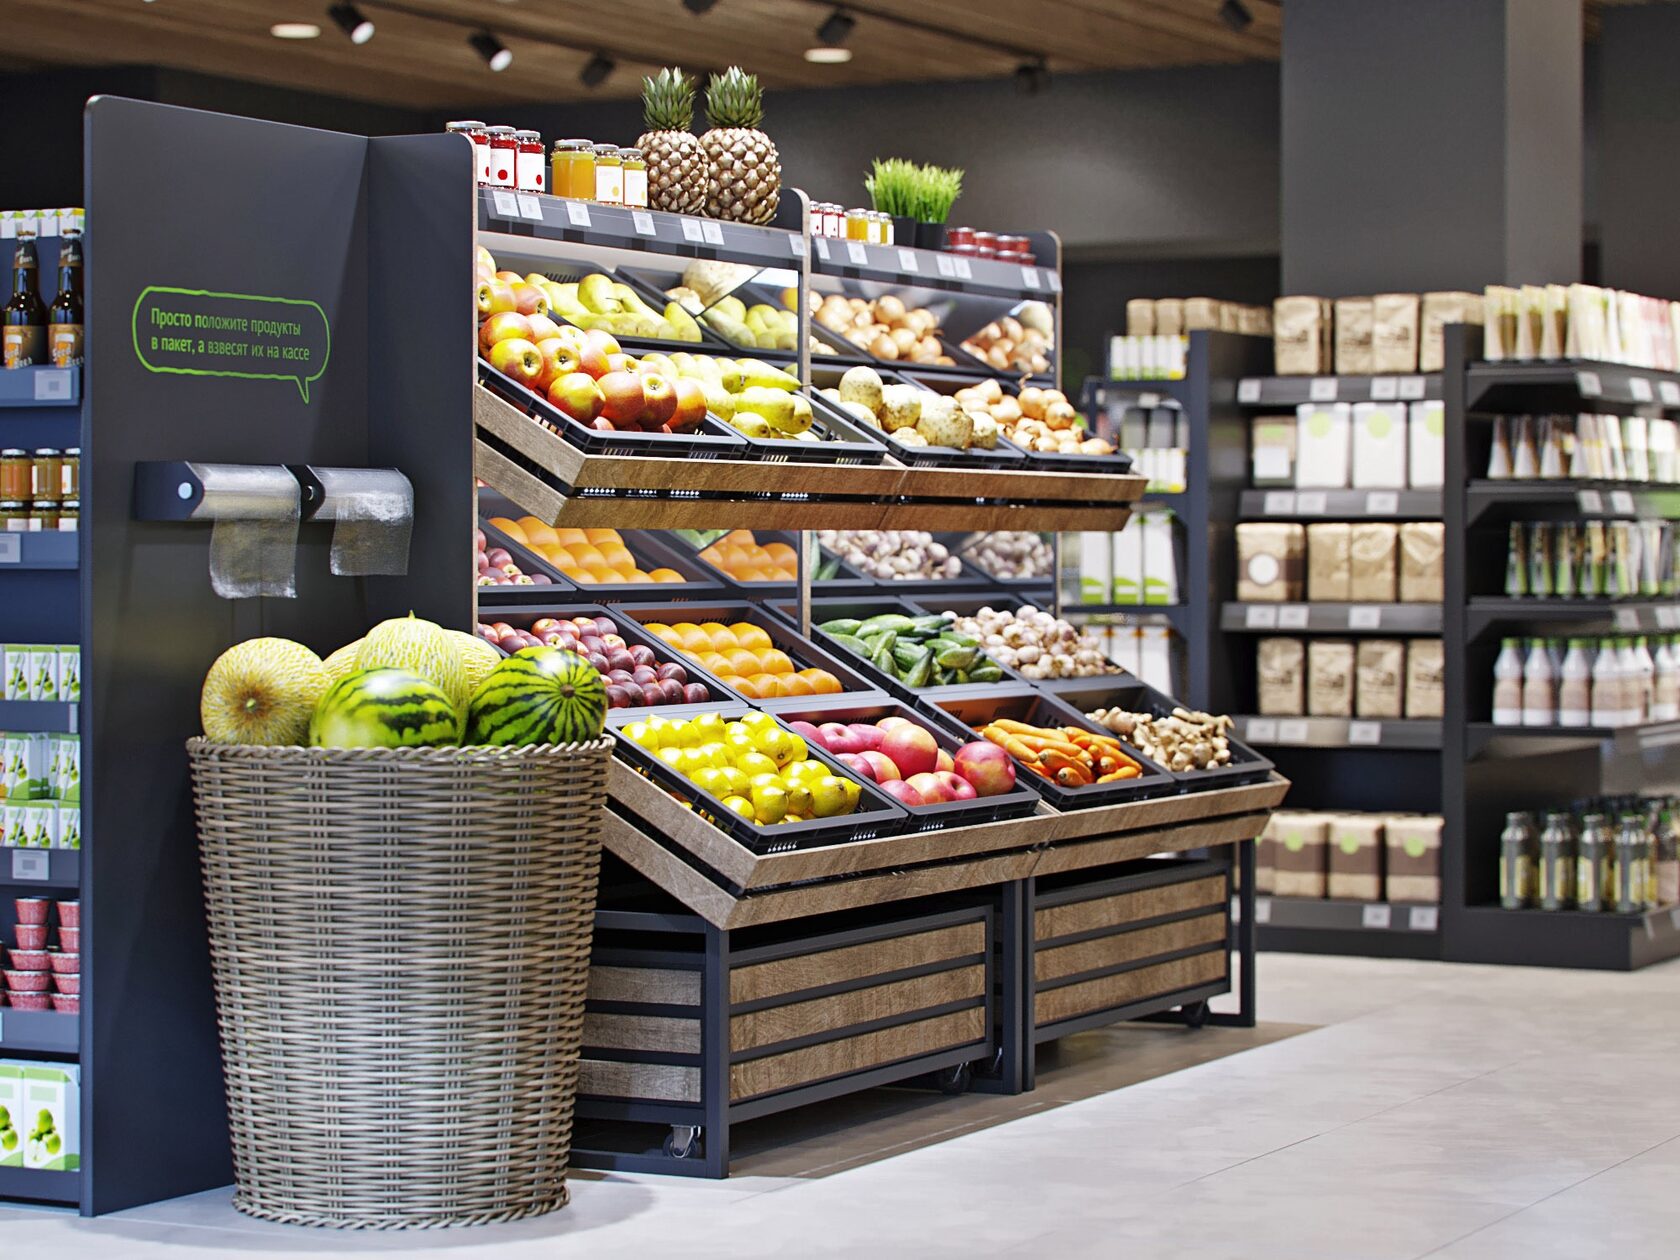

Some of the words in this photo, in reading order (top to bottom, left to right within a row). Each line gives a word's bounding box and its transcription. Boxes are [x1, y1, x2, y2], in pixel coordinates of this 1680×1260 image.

[151, 308, 192, 329] Просто
[194, 315, 248, 331] положите
[250, 319, 301, 338] продукты
[151, 336, 158, 350] в
[161, 337, 195, 355] пакет,
[198, 340, 205, 353] а
[208, 341, 248, 356] взвесят
[251, 343, 264, 357] их
[267, 345, 279, 358] на
[282, 346, 310, 360] кассе
